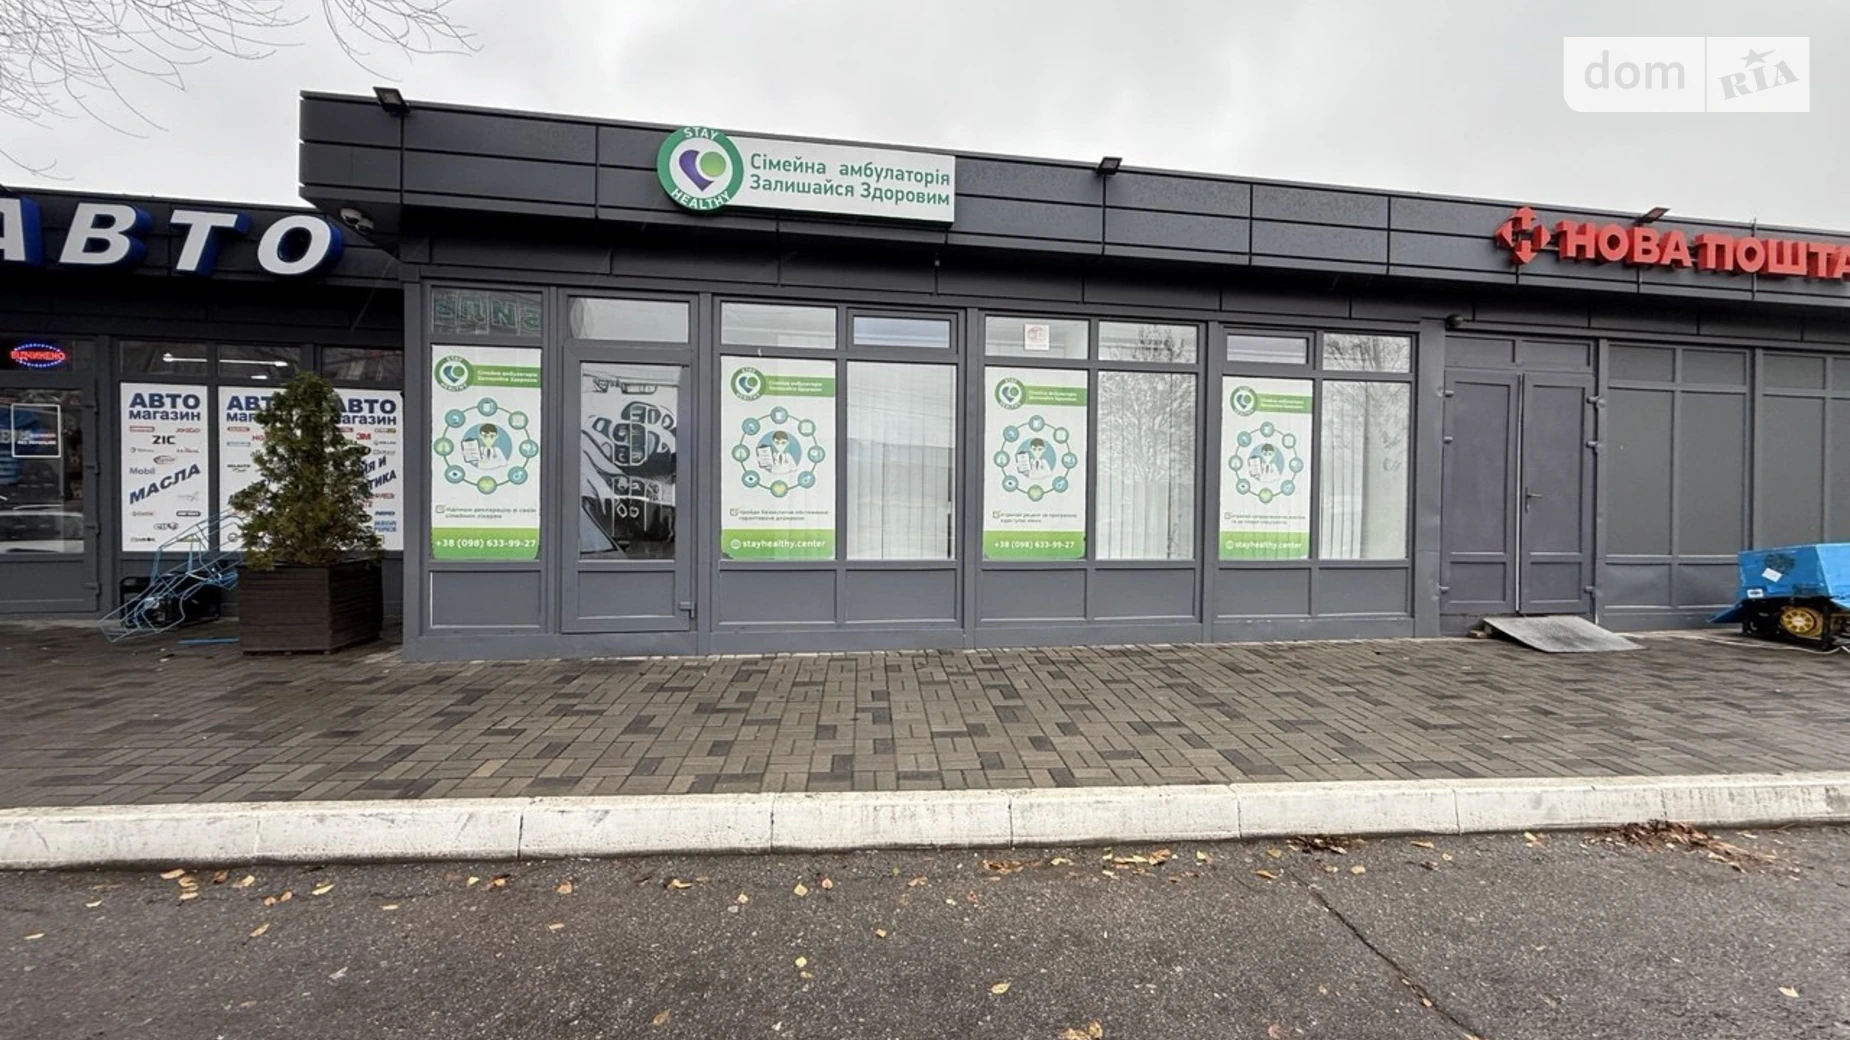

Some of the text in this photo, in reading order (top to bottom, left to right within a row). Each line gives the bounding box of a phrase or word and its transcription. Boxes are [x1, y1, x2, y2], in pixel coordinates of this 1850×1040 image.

[683, 127, 719, 140] STAY
[750, 152, 950, 187] Сімейна амбулаторія
[749, 174, 950, 206] Залишайся Здоровим
[670, 188, 732, 210] HEALTHY
[1556, 219, 1850, 280] НОВА ПОШТА
[129, 392, 201, 410] АВТО
[226, 395, 276, 411] АВТ
[128, 409, 201, 421] магазин
[151, 434, 176, 445] ZIC
[129, 467, 156, 475] Mobil
[129, 463, 201, 505] МАСЛА
[436, 540, 455, 548] +38
[742, 539, 826, 550] stayhealthy.center
